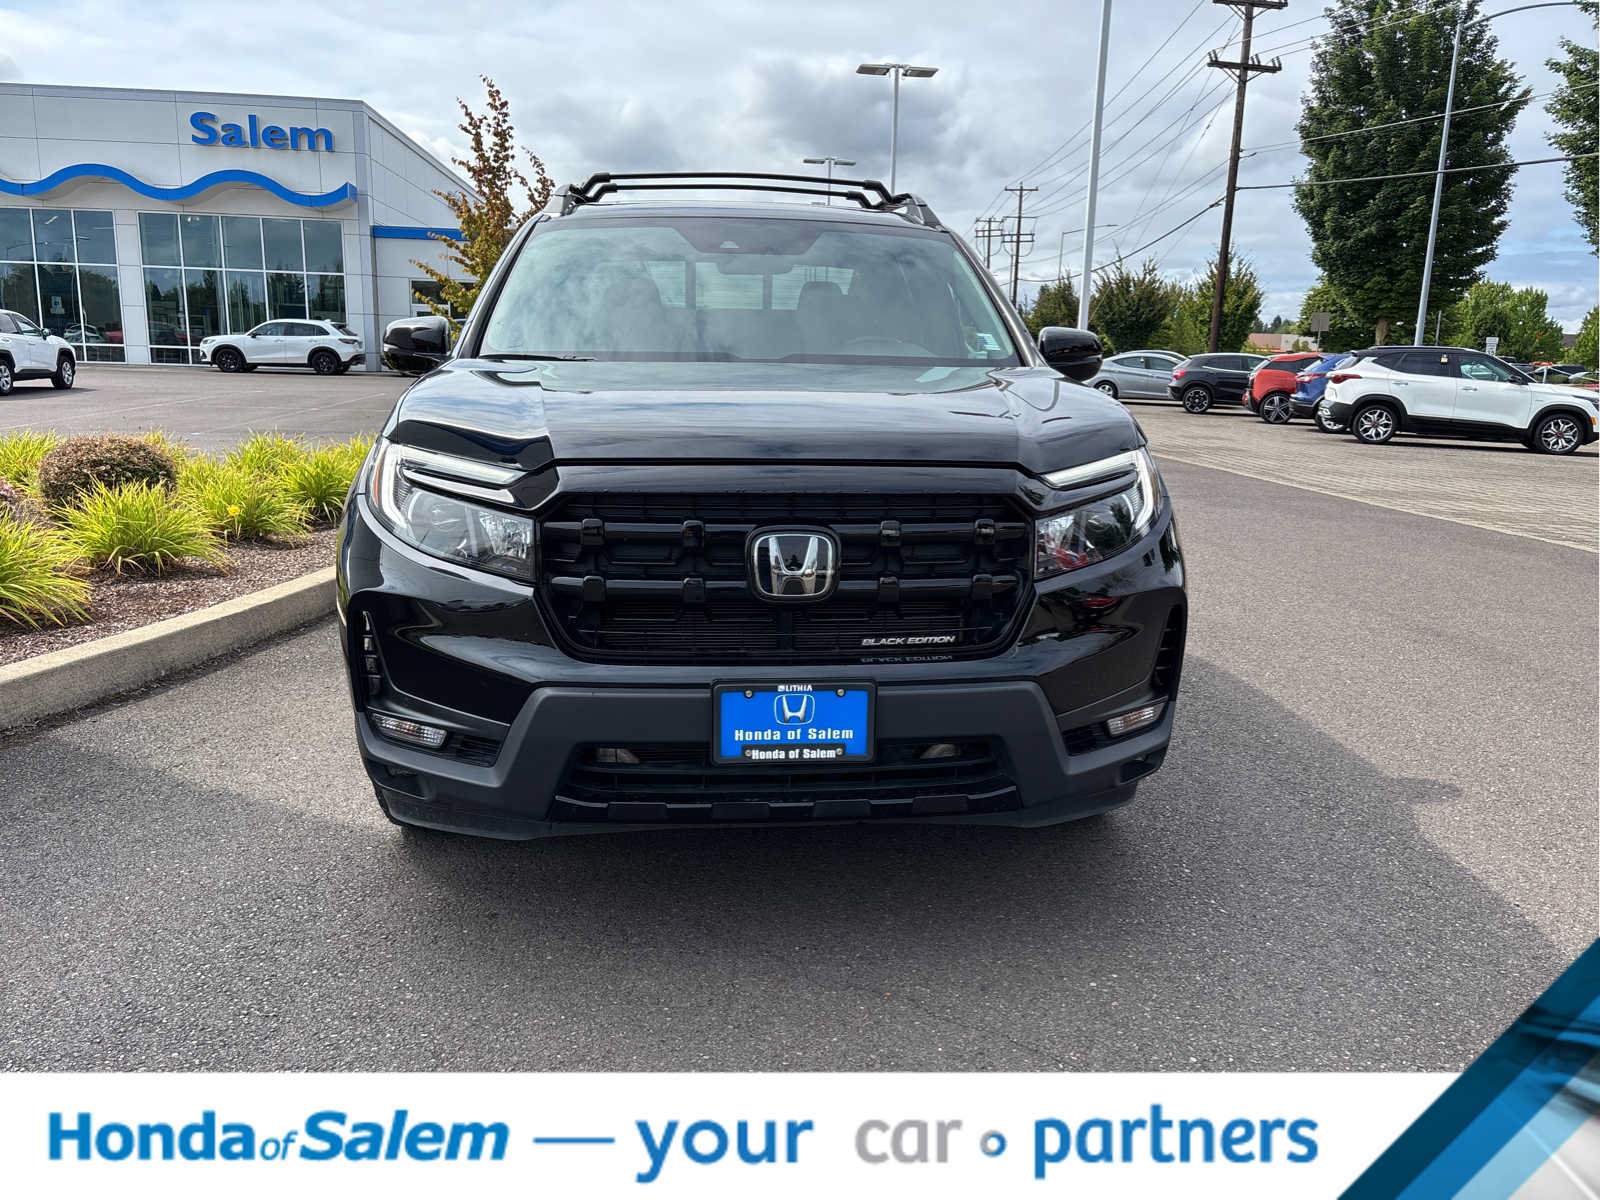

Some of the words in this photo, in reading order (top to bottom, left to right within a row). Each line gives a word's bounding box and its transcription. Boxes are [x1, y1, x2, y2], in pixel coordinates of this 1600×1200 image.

[190, 111, 334, 152] Salem
[862, 637, 906, 646] BLACK
[907, 635, 955, 645] EDITION
[785, 684, 812, 692] LITHIA
[734, 729, 781, 741] Honda
[787, 728, 802, 740] of
[808, 728, 854, 740] Salem
[751, 749, 785, 760] Honda
[788, 749, 800, 759] of
[803, 748, 836, 759] Salem
